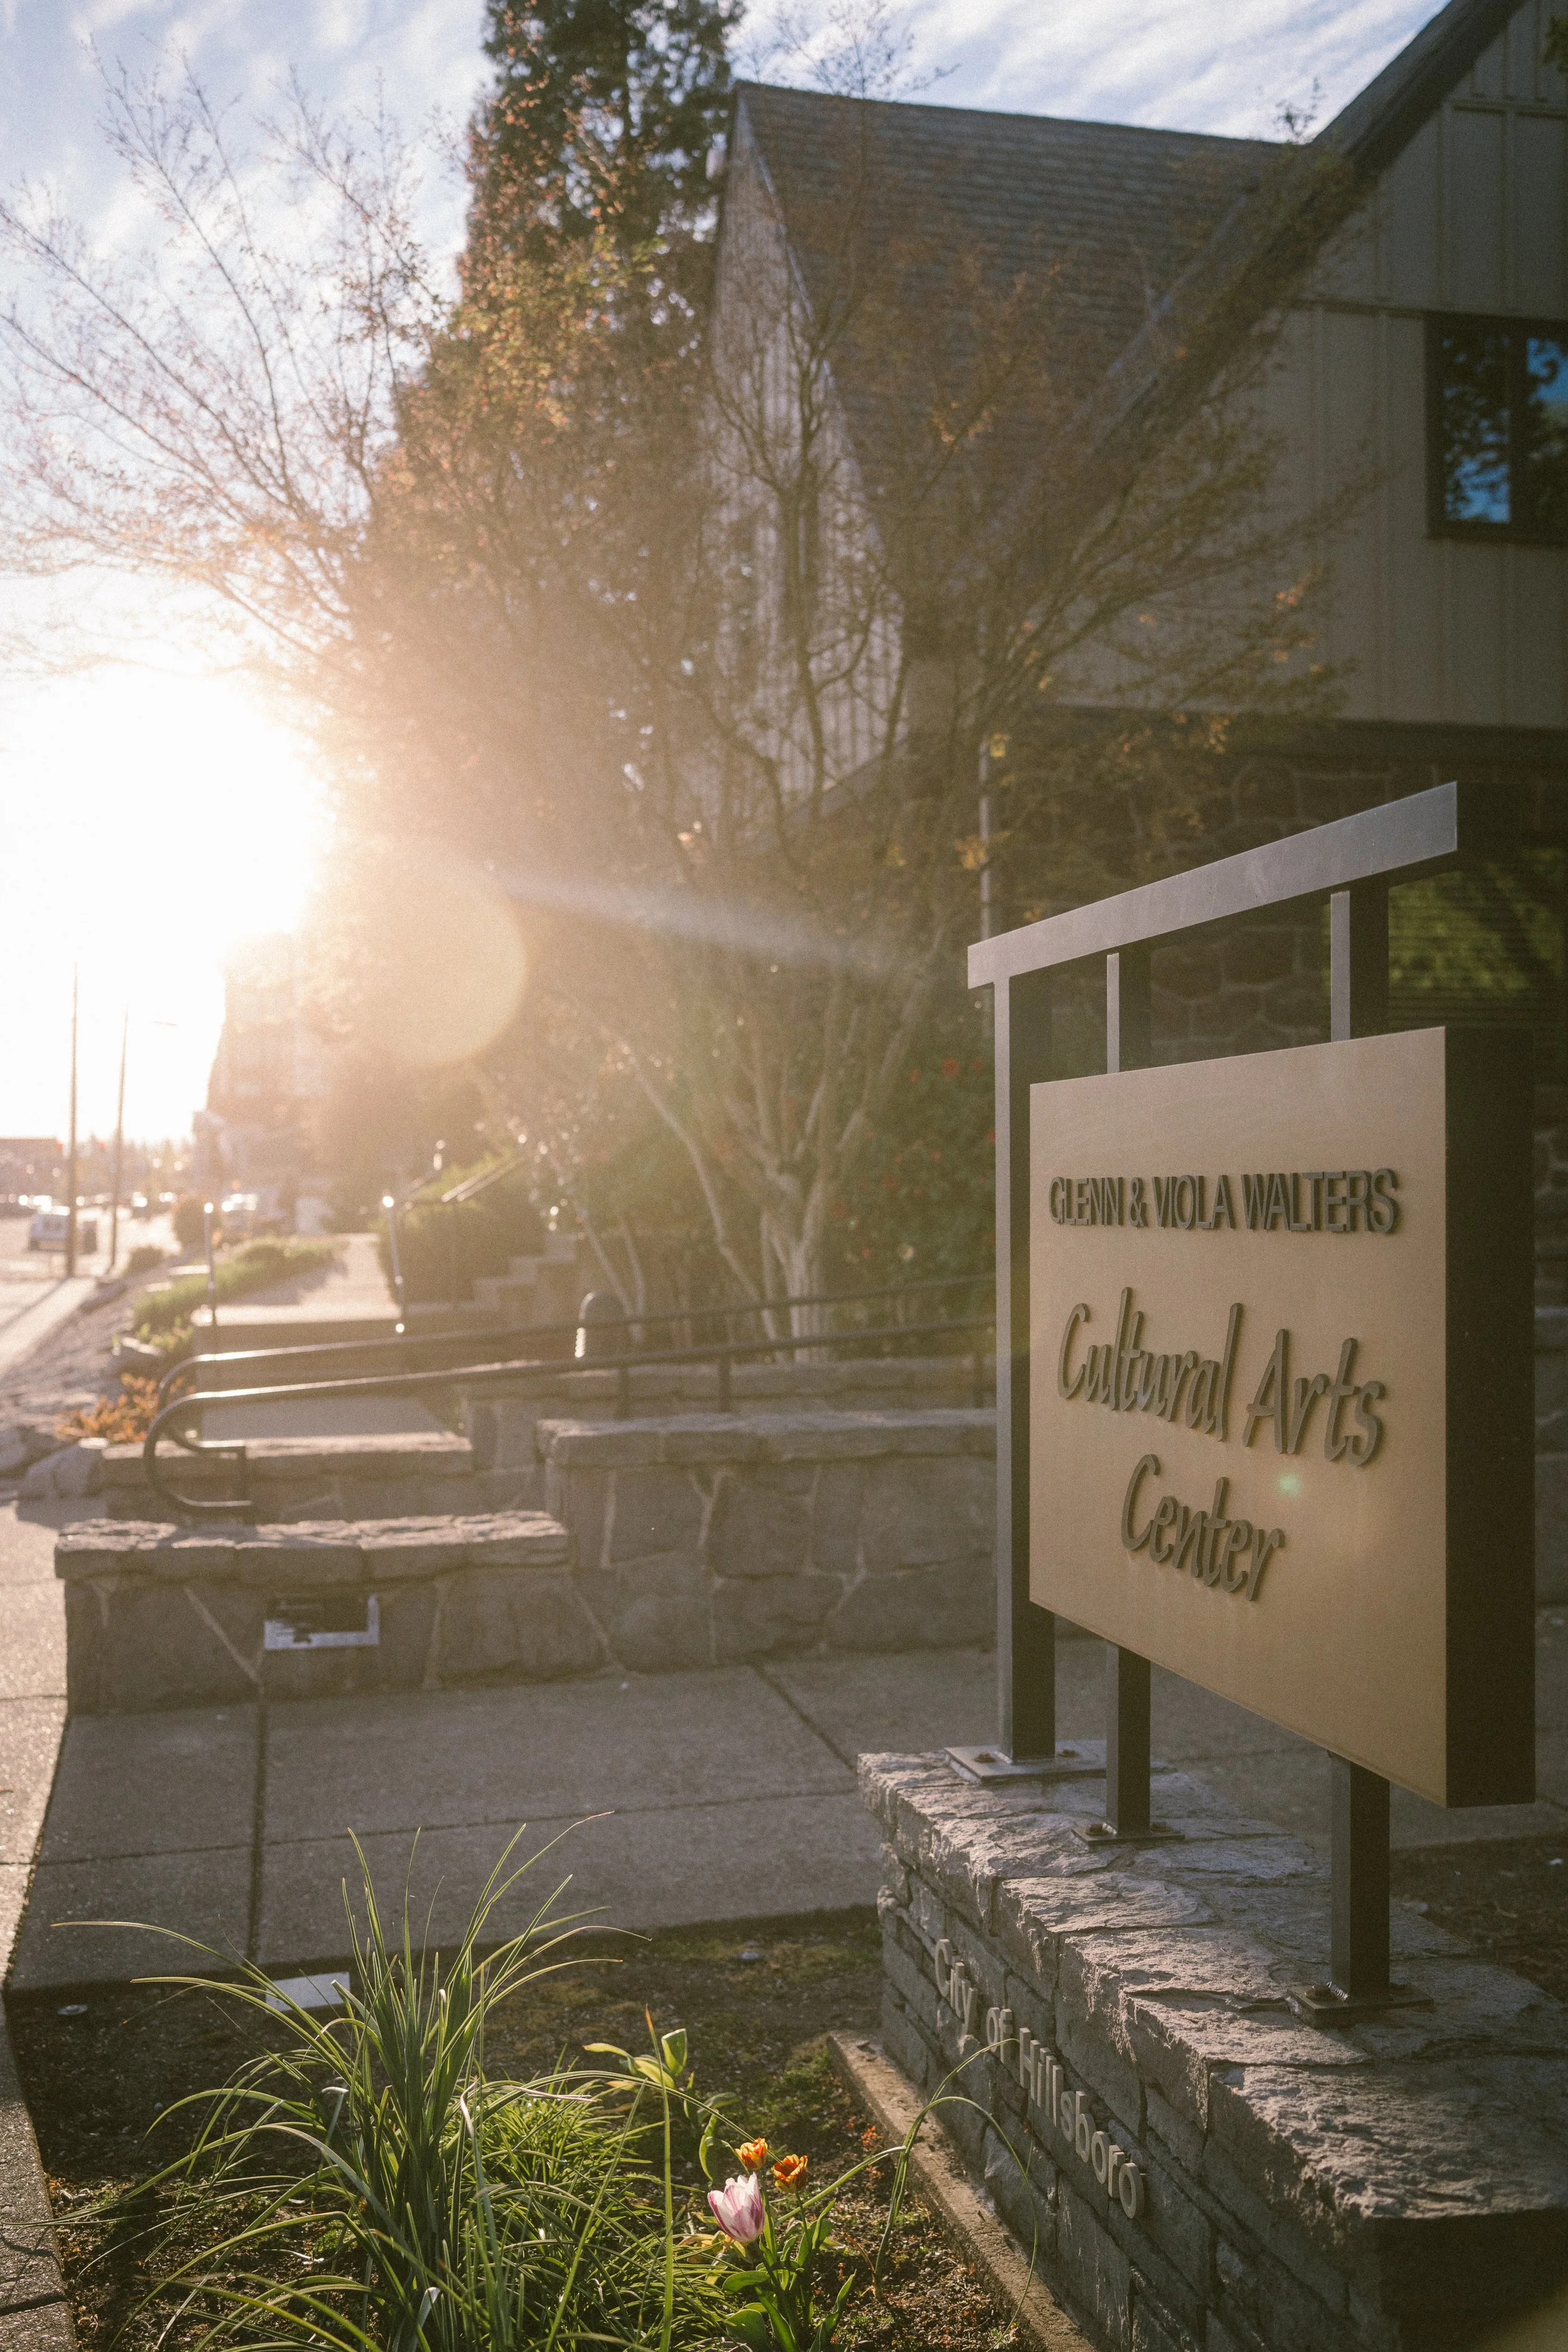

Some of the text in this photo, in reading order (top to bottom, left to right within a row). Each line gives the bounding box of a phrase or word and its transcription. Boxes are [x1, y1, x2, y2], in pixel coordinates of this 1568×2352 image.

[1049, 1168, 1398, 1234] GLENN & VIOLA WALTERS
[1057, 1287, 1385, 1466] Cultural Arts
[1121, 1454, 1285, 1602] Center
[935, 1938, 1144, 2219] City of Hillsboro
